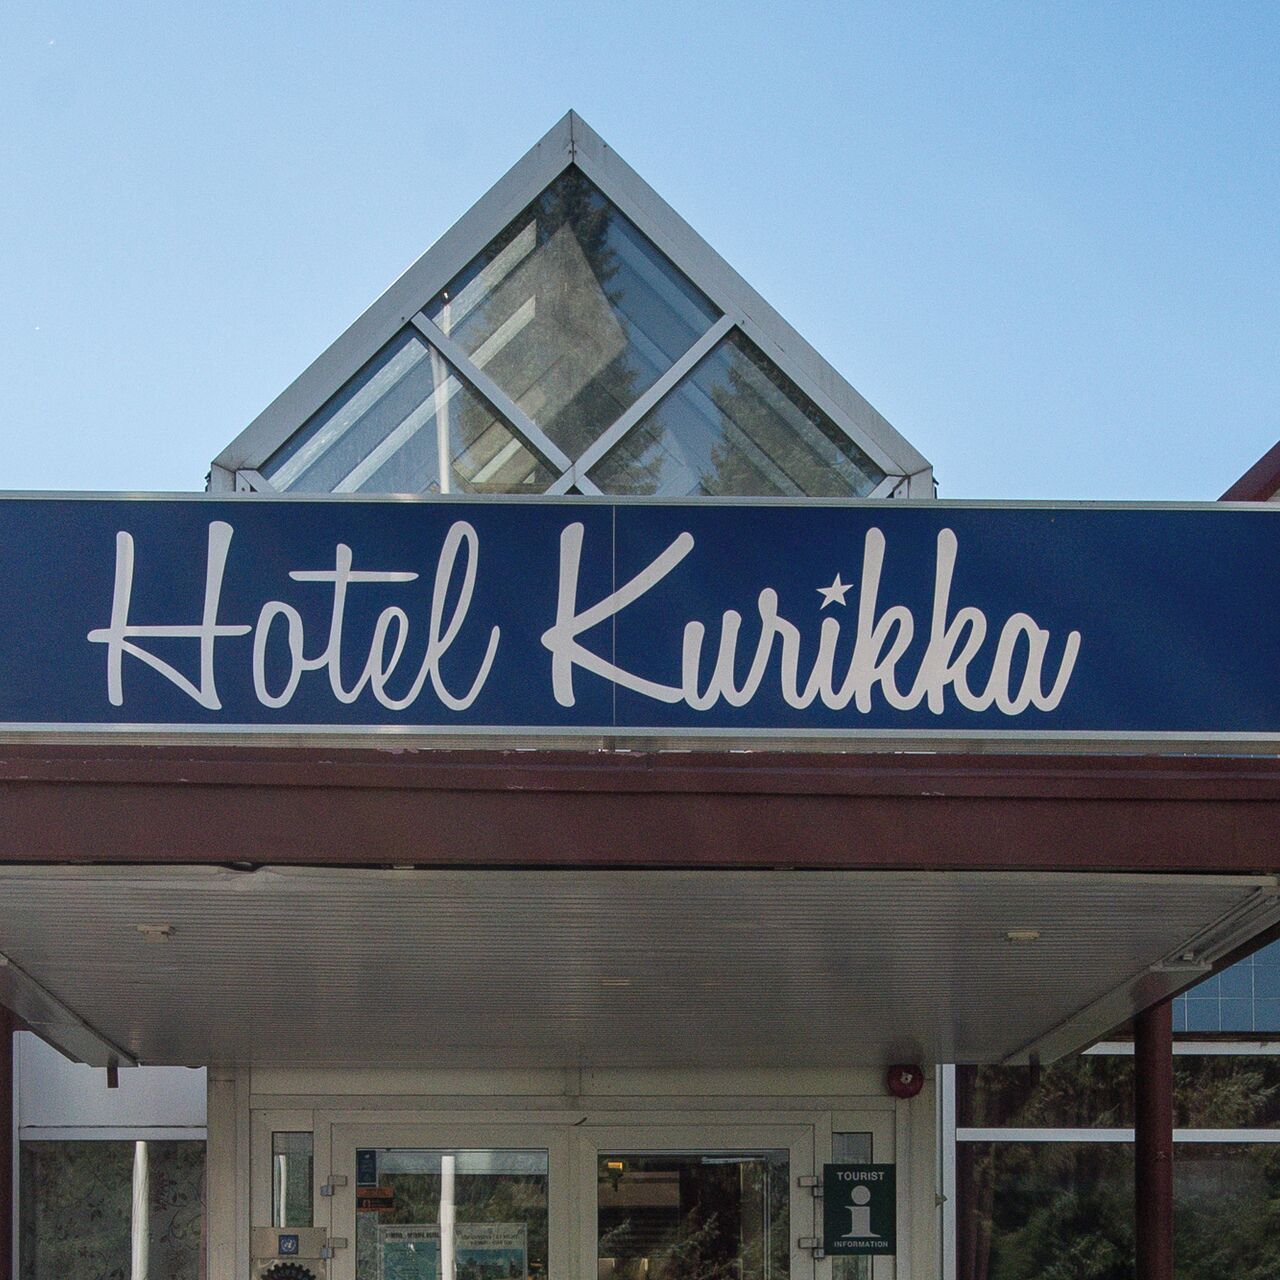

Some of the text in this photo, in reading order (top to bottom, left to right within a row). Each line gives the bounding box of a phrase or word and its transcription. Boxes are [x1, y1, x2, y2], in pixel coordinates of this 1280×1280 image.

[87, 520, 1082, 716] Hotel Kurikka
[836, 1171, 886, 1181] TOURIST
[833, 1240, 889, 1248] INFORMATION
